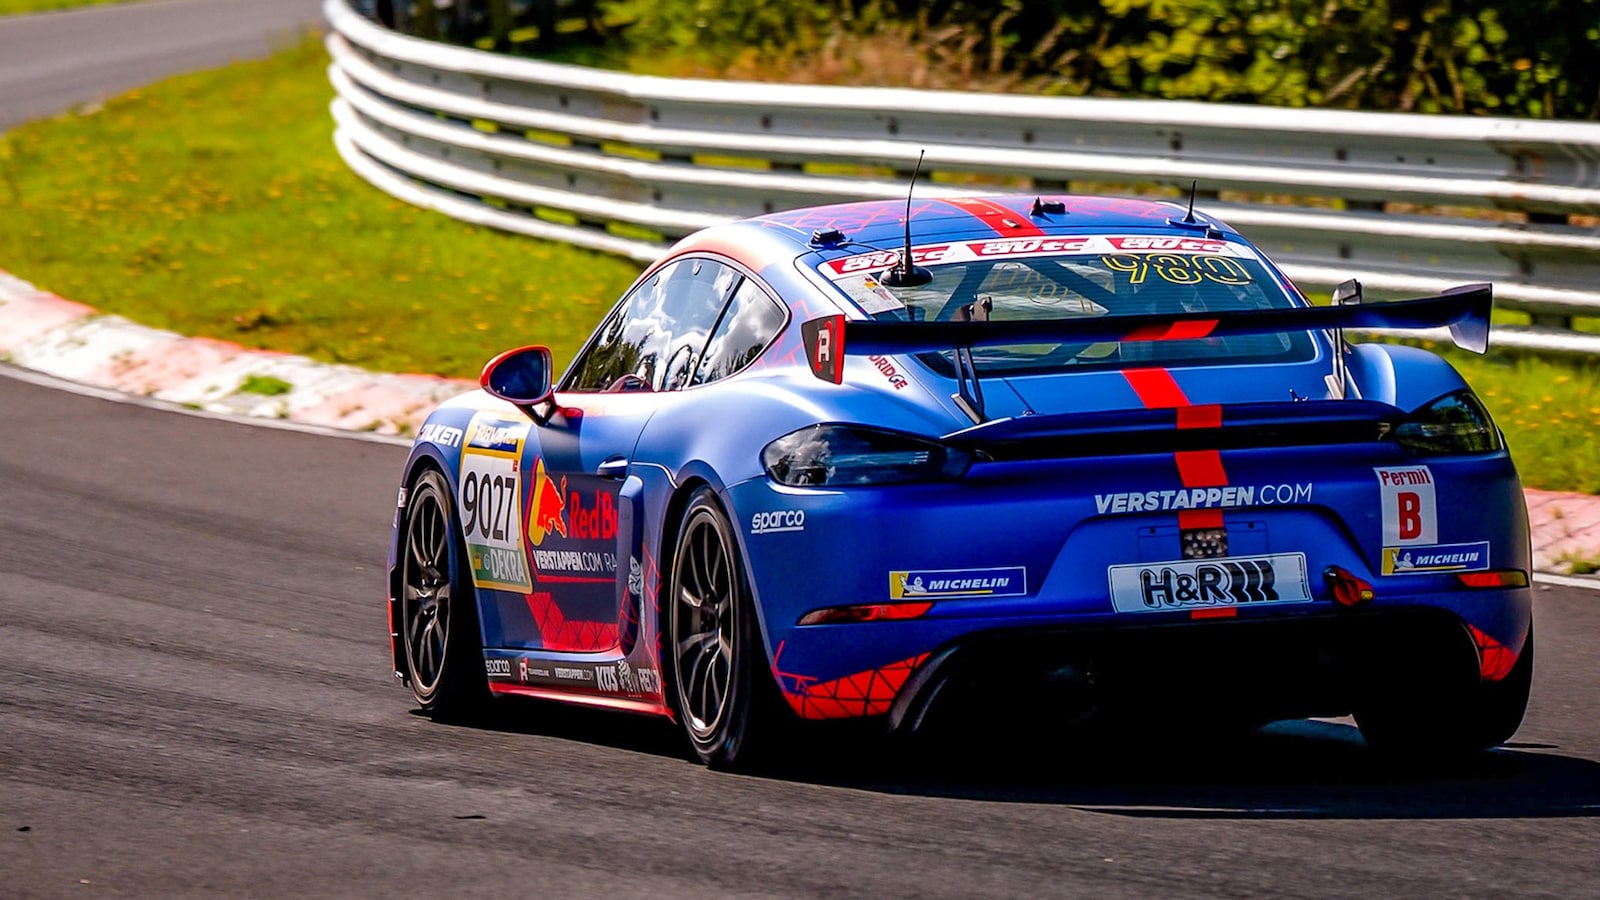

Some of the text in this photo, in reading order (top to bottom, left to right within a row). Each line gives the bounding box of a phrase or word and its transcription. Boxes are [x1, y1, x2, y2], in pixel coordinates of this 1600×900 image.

[1102, 253, 1252, 285] 980
[1379, 469, 1431, 486] Permit
[463, 471, 516, 543] 9027
[1094, 482, 1313, 514] VERSTAPPEN.COM
[569, 490, 600, 539] Red
[751, 510, 804, 534] sparco
[1398, 492, 1422, 540] B
[491, 549, 527, 583] DEKRA
[533, 550, 603, 571] VERSTAPPEN.COM
[1416, 552, 1479, 566] MICHELIN
[928, 576, 1010, 590] MICHELIN
[1141, 565, 1230, 607] H&R
